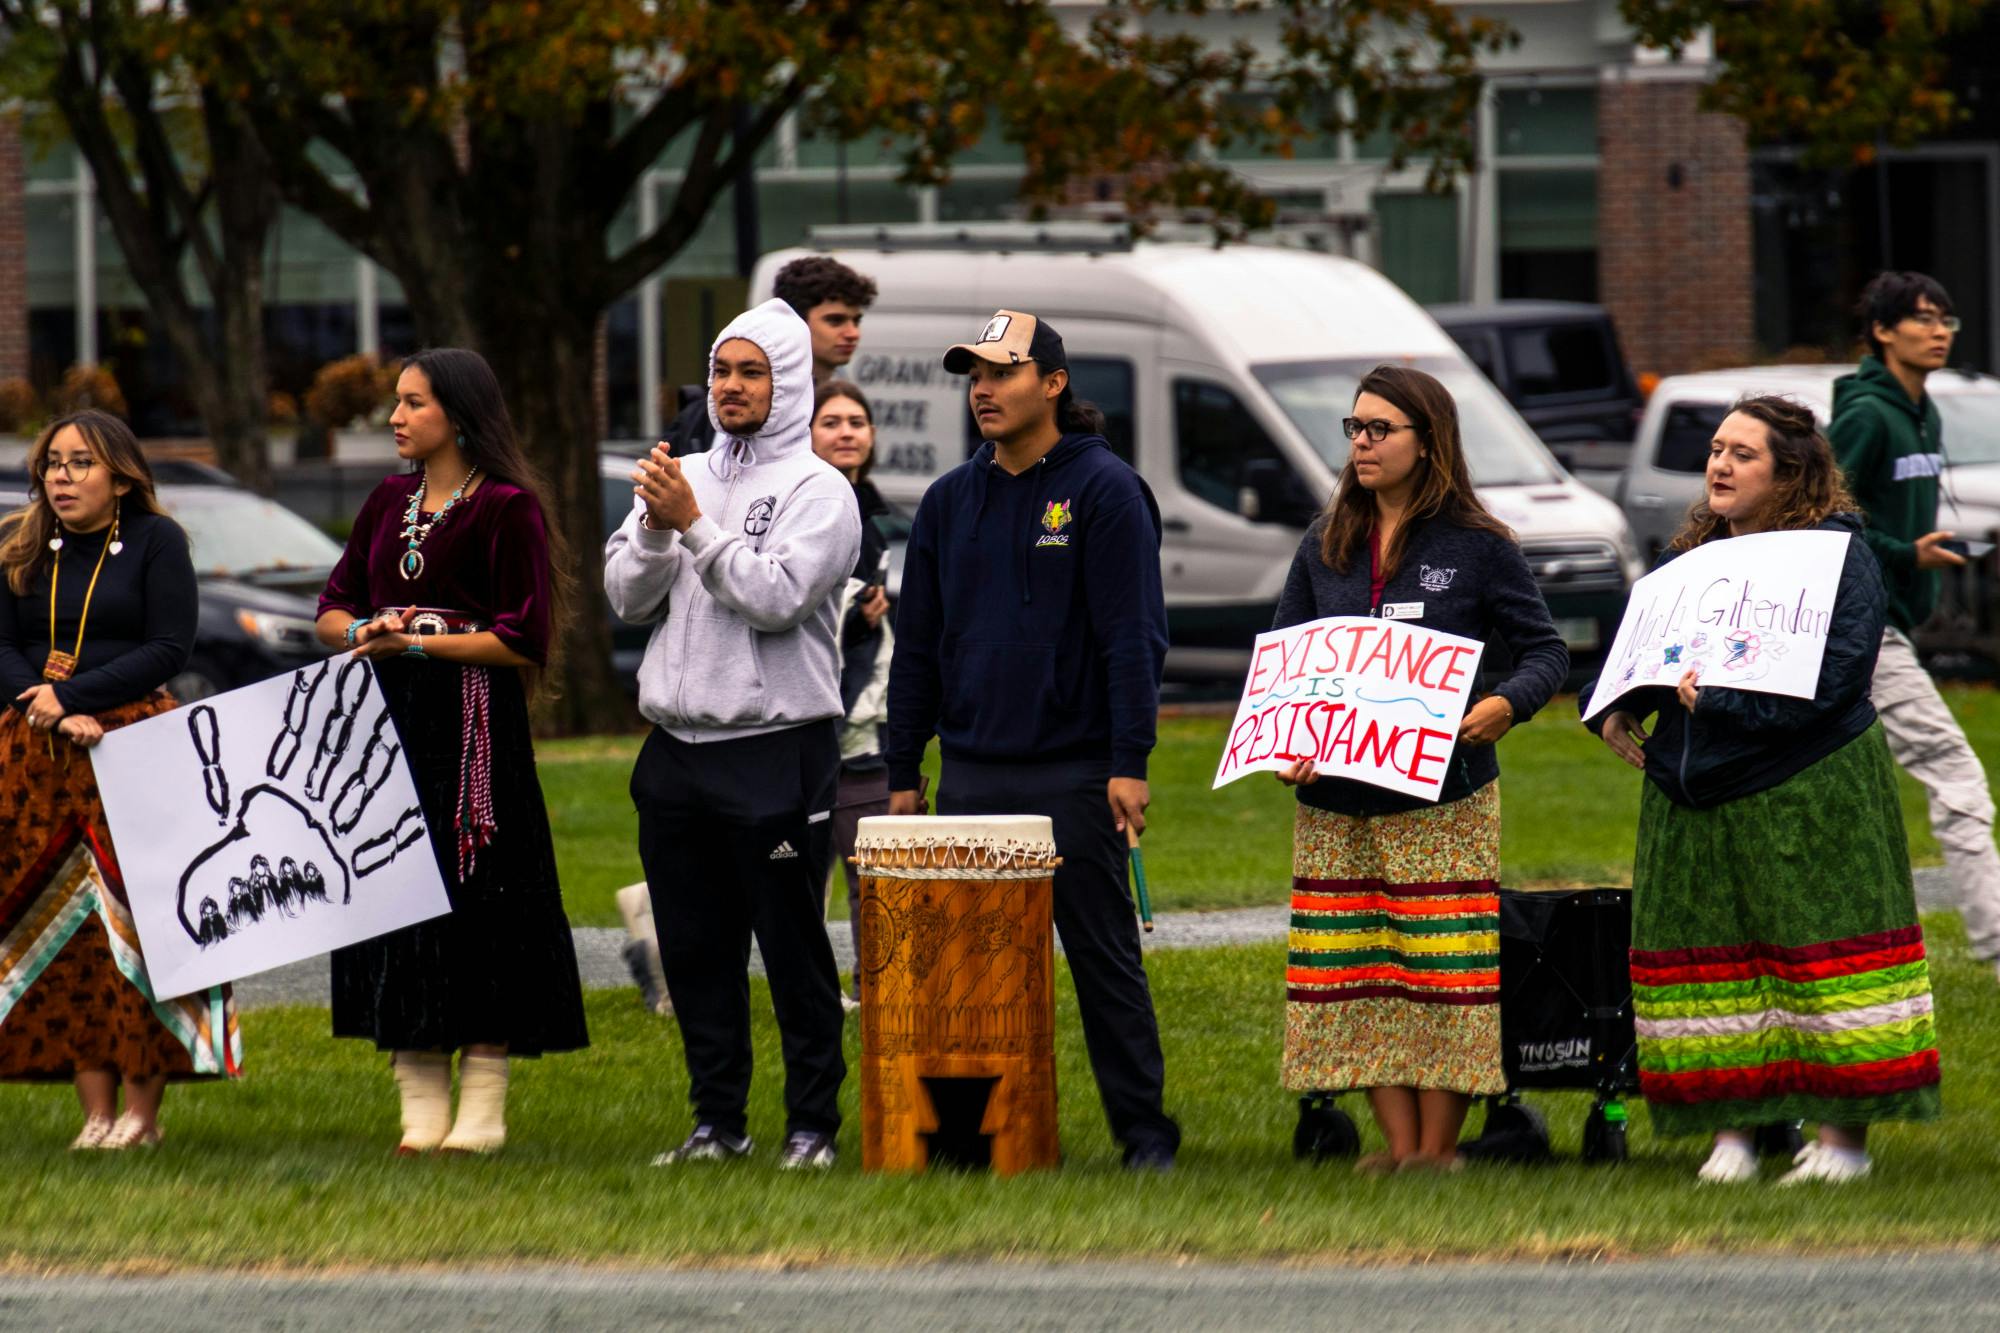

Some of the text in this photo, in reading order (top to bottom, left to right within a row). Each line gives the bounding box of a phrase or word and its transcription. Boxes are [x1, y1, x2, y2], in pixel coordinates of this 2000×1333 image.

[1248, 625, 1475, 697] EXISTANCE
[1305, 677, 1344, 697] IS
[1221, 700, 1453, 786] RESISTANCE
[769, 851, 798, 860] adidas
